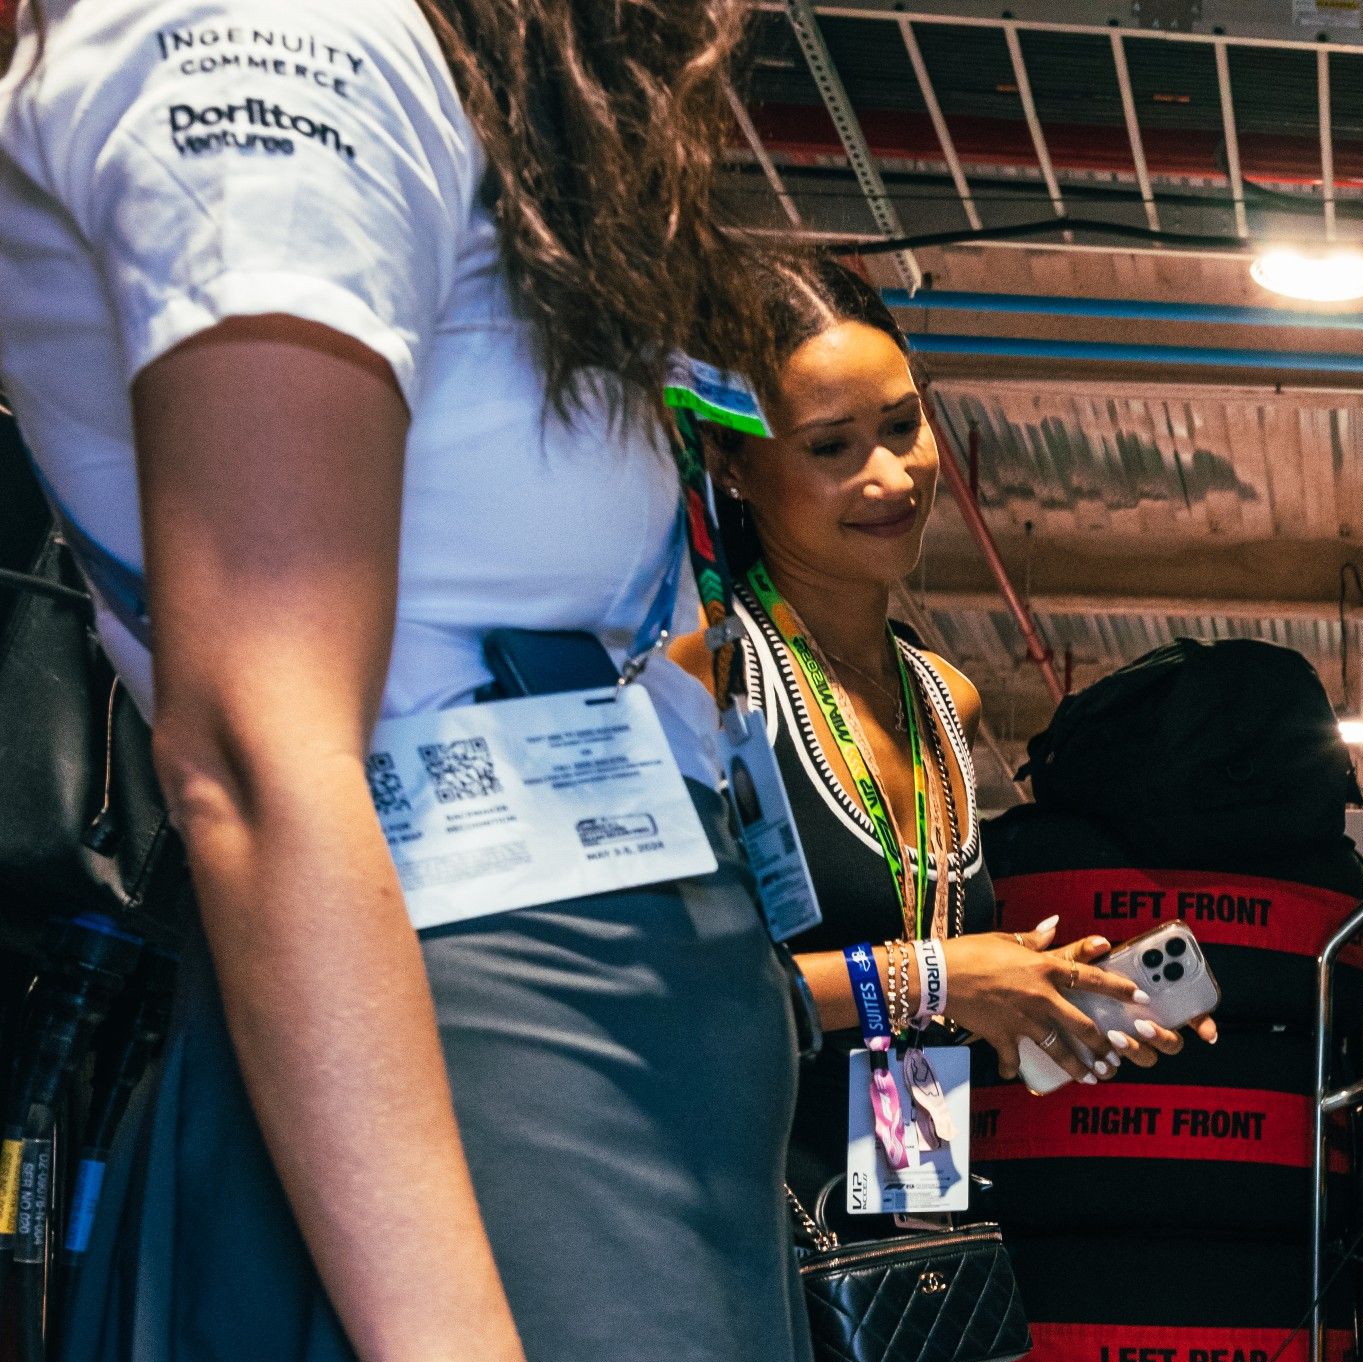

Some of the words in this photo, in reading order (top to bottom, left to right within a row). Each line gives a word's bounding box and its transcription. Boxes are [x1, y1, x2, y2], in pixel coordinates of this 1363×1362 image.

[156, 28, 363, 74] INGENUITY
[180, 54, 348, 97] COMMERCE
[858, 777, 879, 808] VIP
[1093, 890, 1167, 920] LEFT
[1176, 891, 1273, 928] FRONT
[860, 982, 884, 1032] SUITES
[1069, 1105, 1161, 1136] RIGHT
[1170, 1108, 1267, 1141] FRONT
[852, 1171, 864, 1211] VIP
